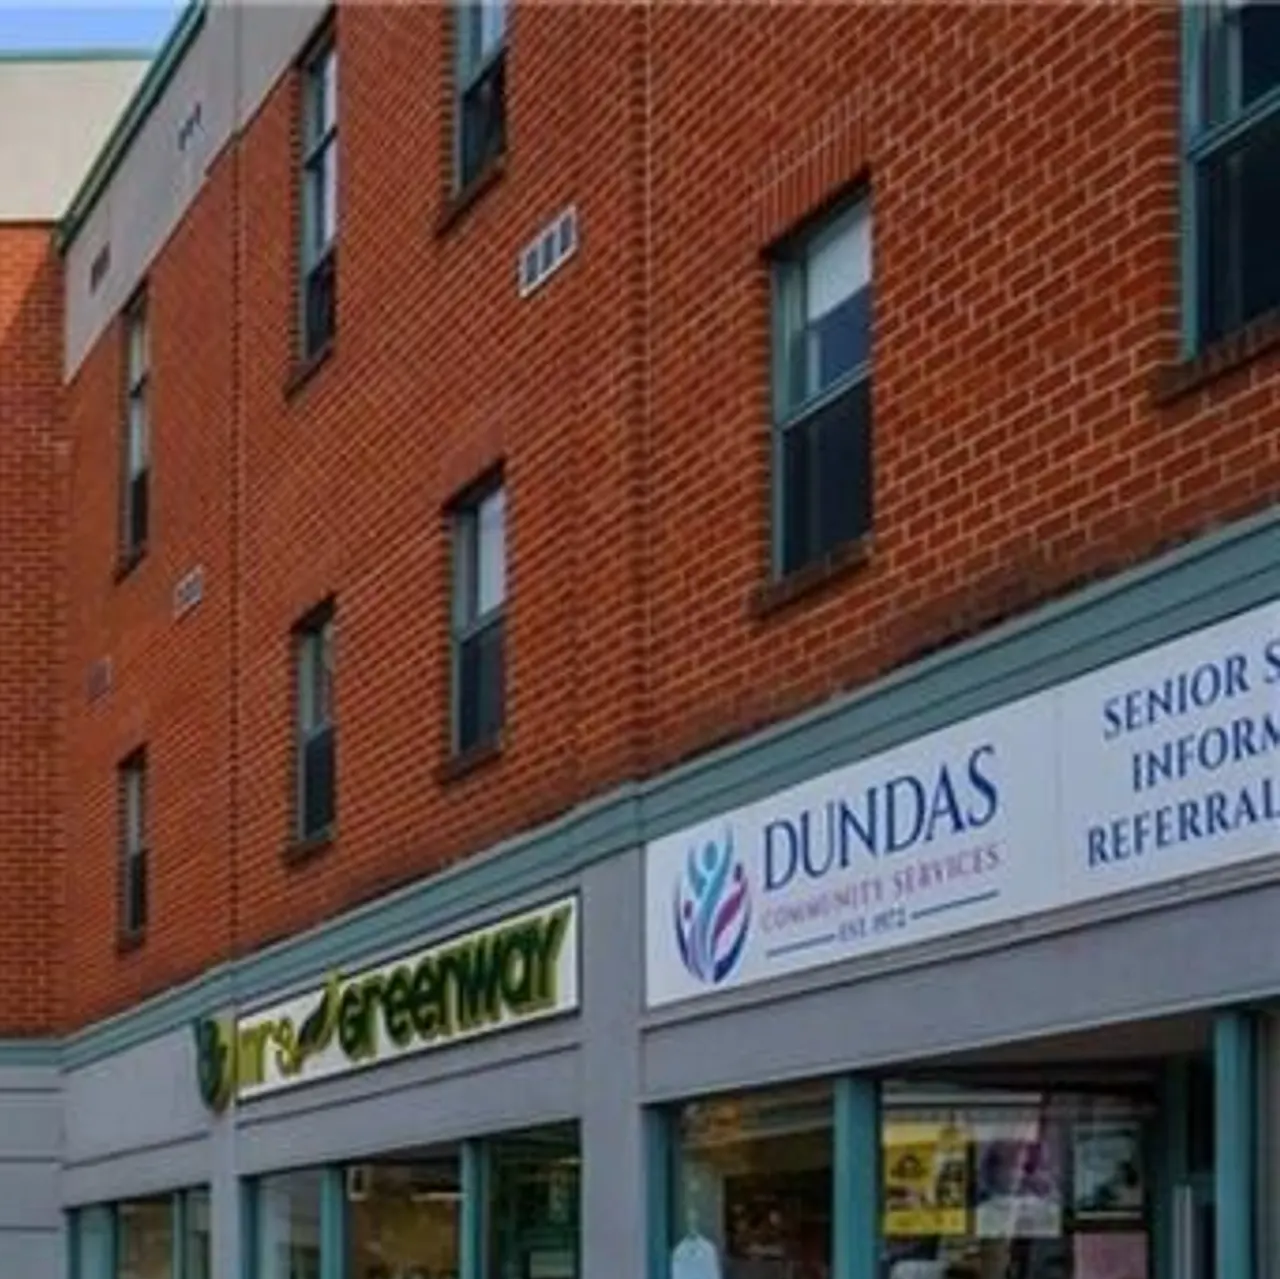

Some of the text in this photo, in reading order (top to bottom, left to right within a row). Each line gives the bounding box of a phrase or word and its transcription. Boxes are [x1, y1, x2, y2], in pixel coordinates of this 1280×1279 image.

[1103, 654, 1250, 741] SENIOR
[763, 743, 998, 891] DUNDAS
[1088, 778, 1280, 868] REFERRAL
[760, 845, 1001, 933] COMMUNITY SERVICES
